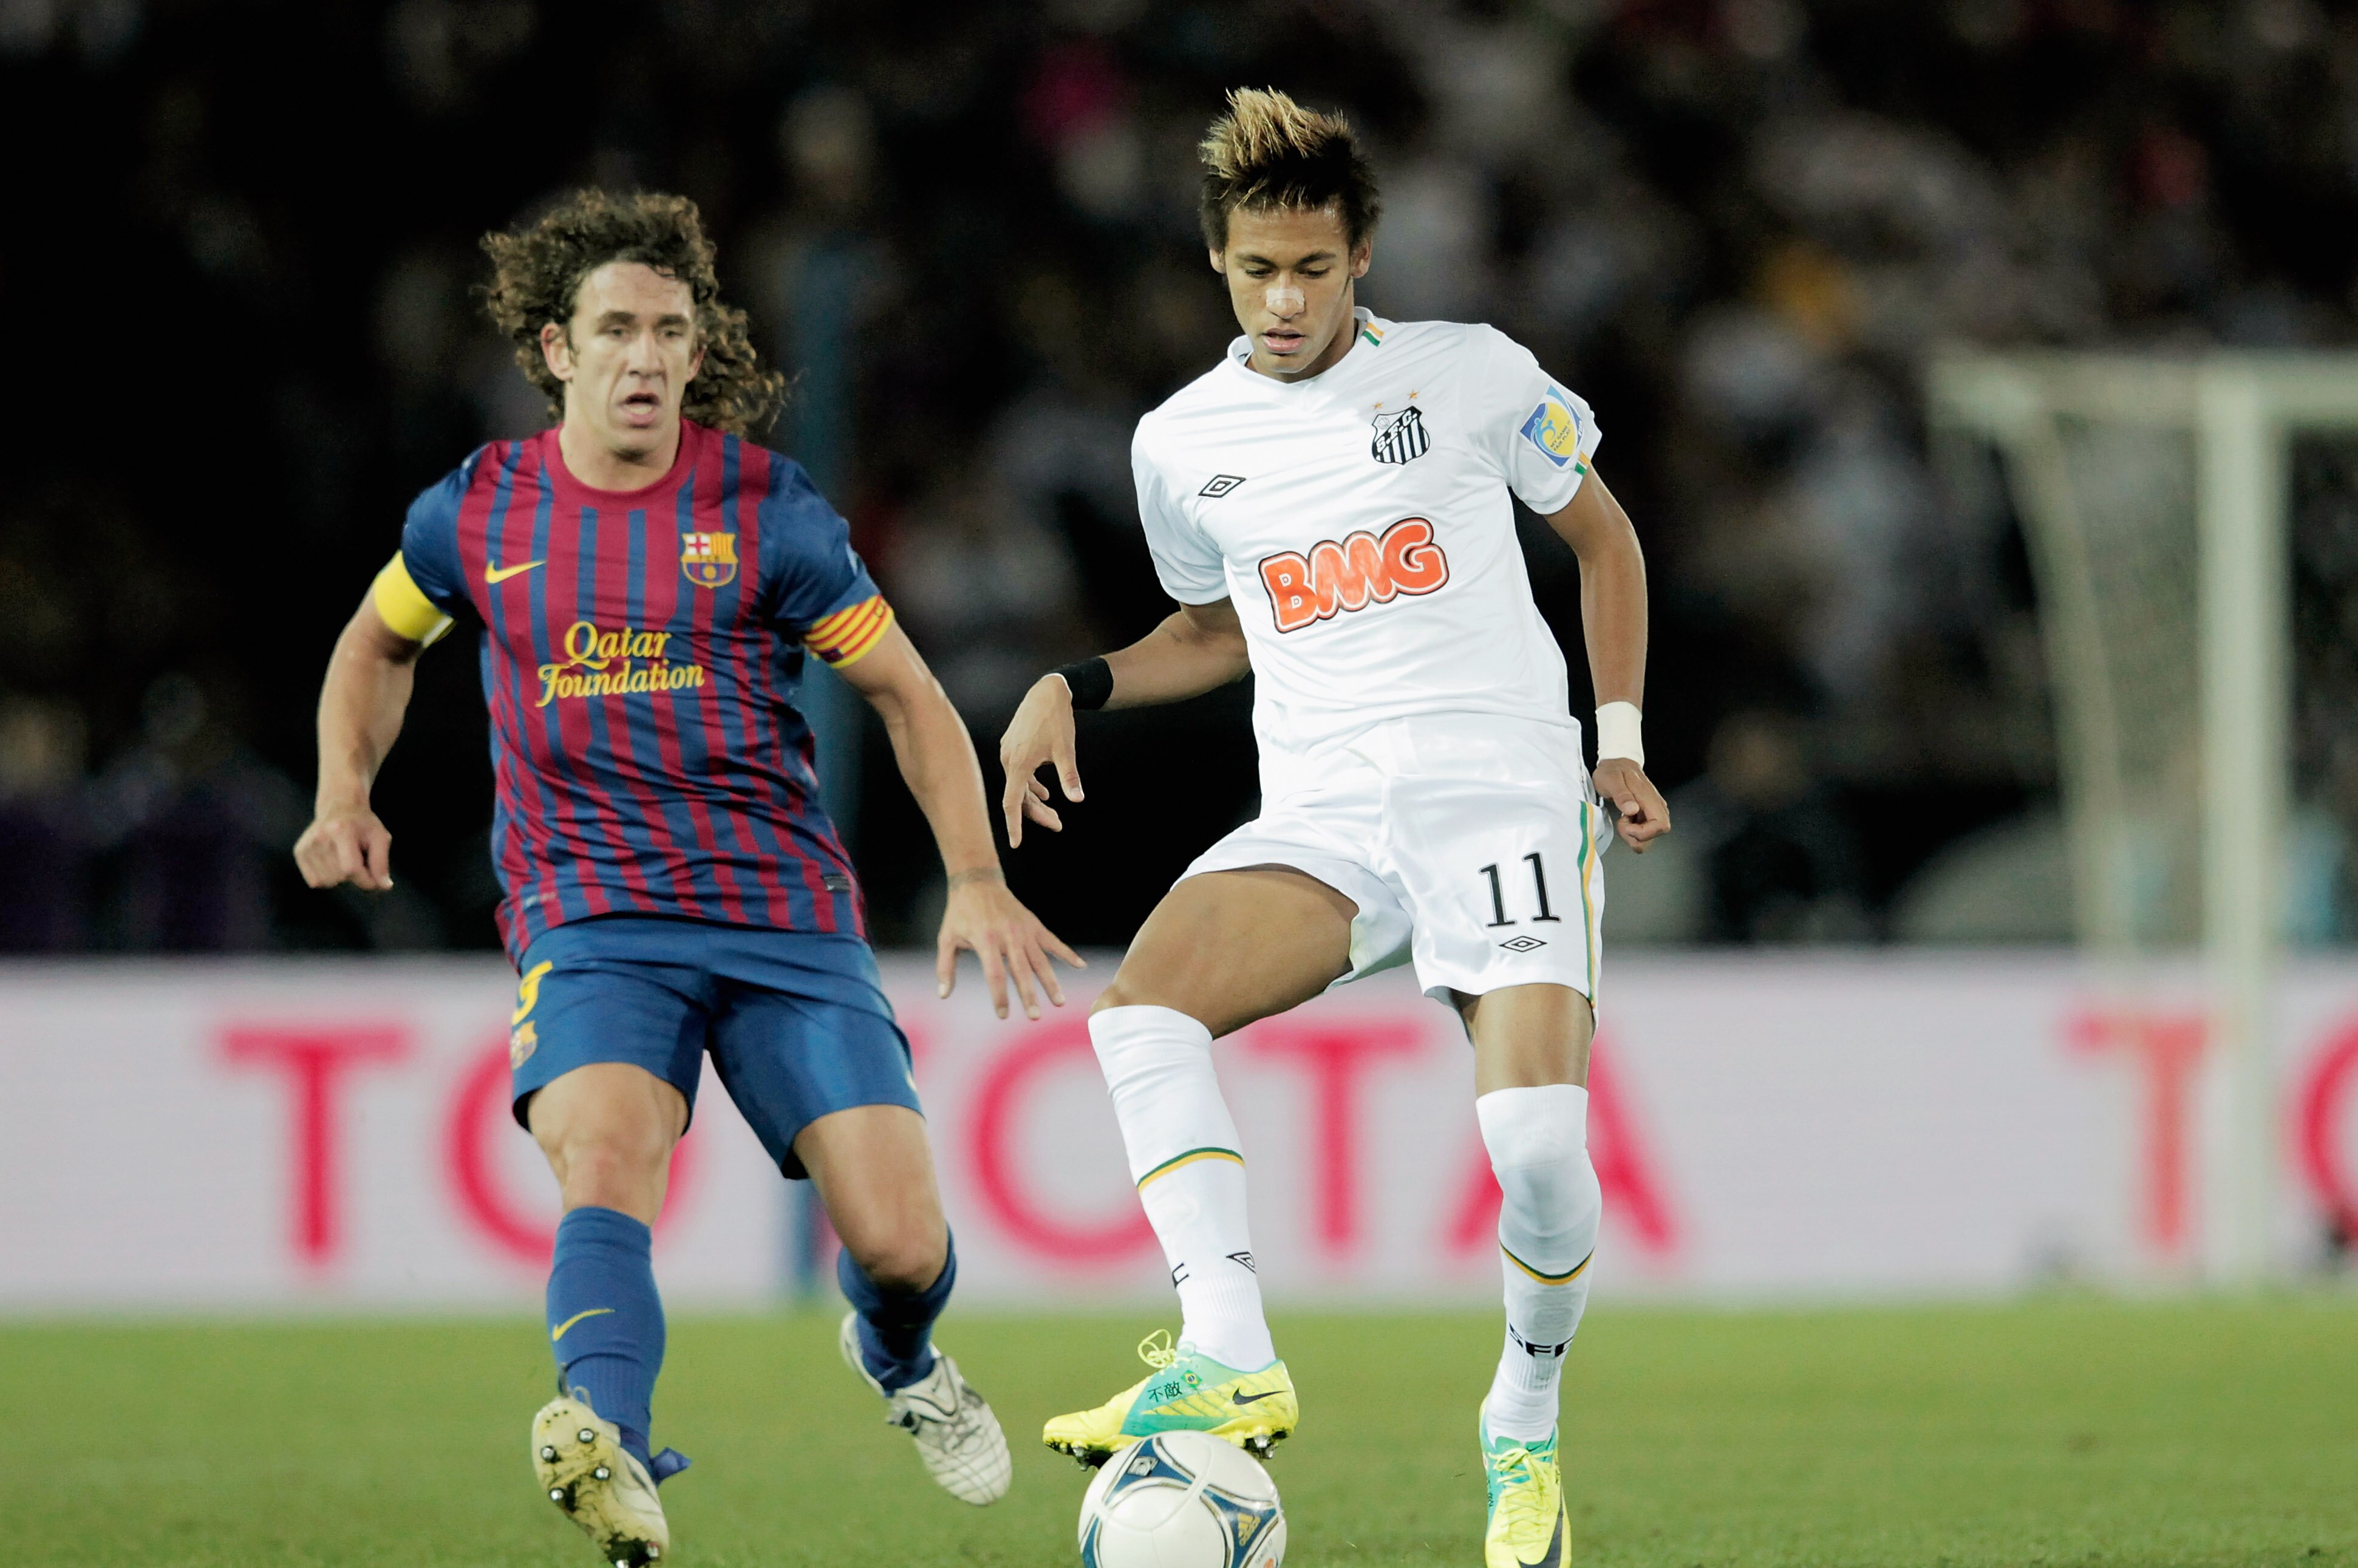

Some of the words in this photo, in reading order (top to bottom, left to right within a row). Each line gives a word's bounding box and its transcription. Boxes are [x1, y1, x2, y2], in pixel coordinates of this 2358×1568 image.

[1259, 517, 1450, 633] BMG
[564, 621, 672, 670] Qatar
[534, 659, 705, 707] Foundation
[1478, 851, 1562, 928] 11
[1147, 1381, 1183, 1403] 不敵
